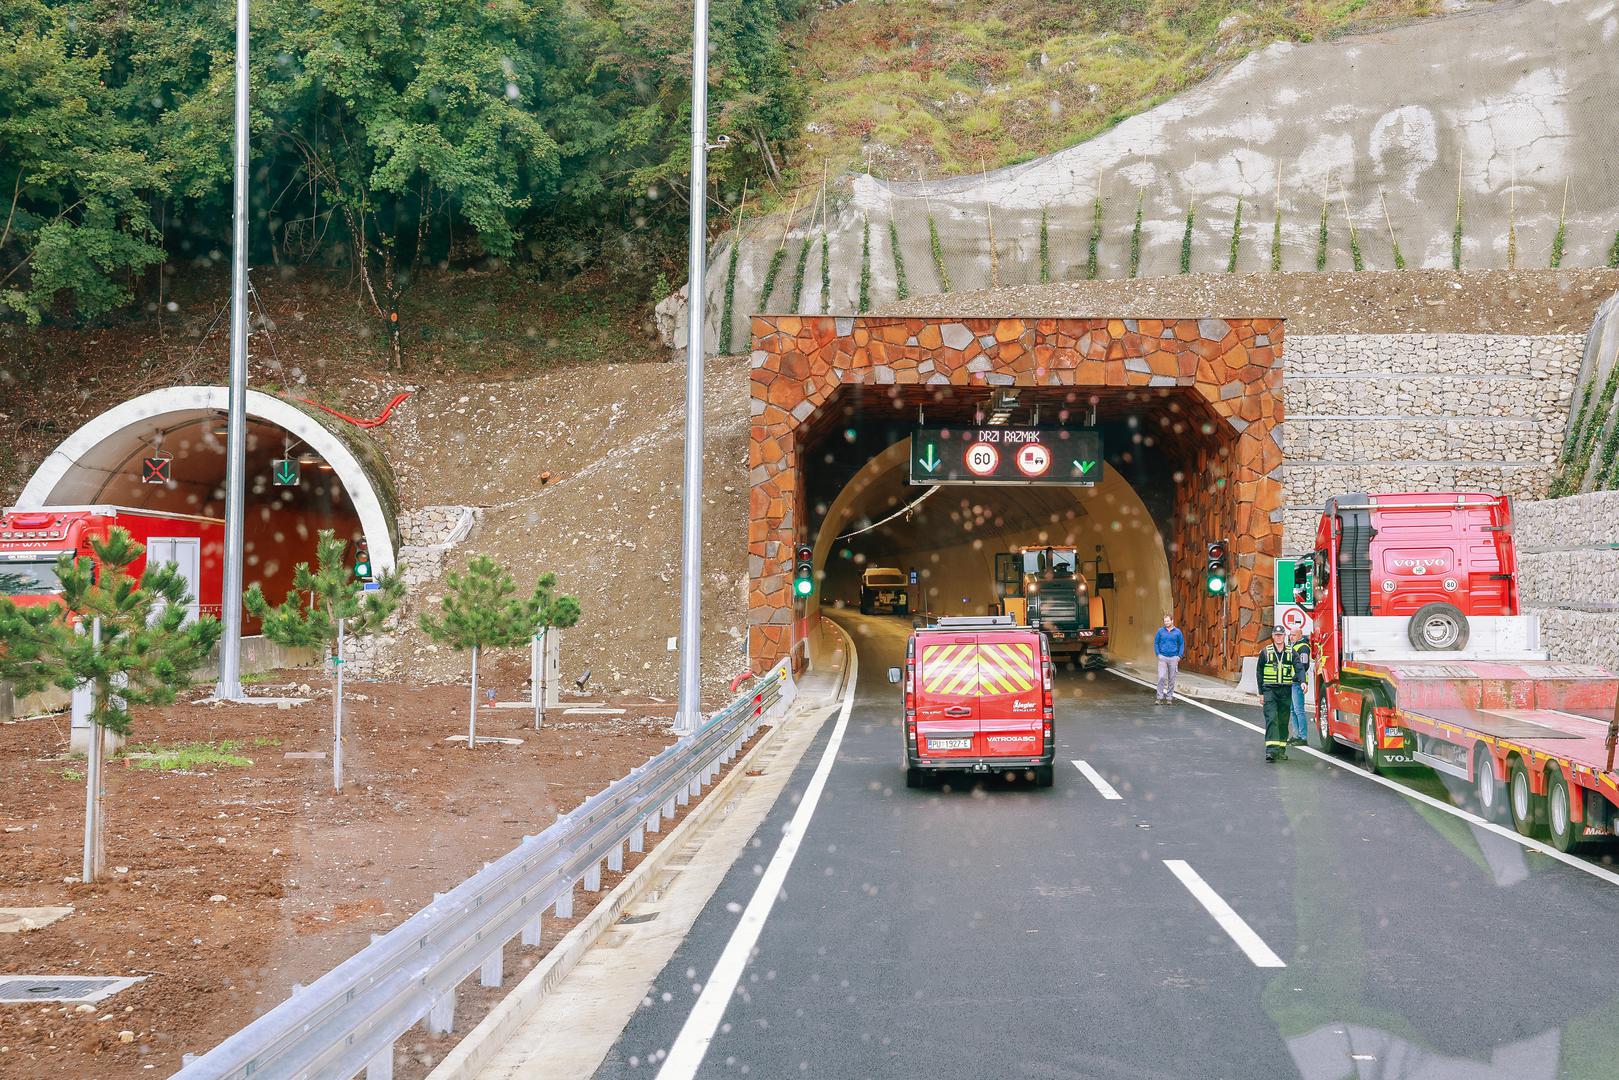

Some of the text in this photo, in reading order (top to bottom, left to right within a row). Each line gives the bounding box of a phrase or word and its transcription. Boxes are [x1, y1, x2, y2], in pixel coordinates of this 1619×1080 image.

[1004, 430, 1040, 442] RAZMAK
[974, 452, 990, 465] 60
[1393, 559, 1445, 567] VOLVO
